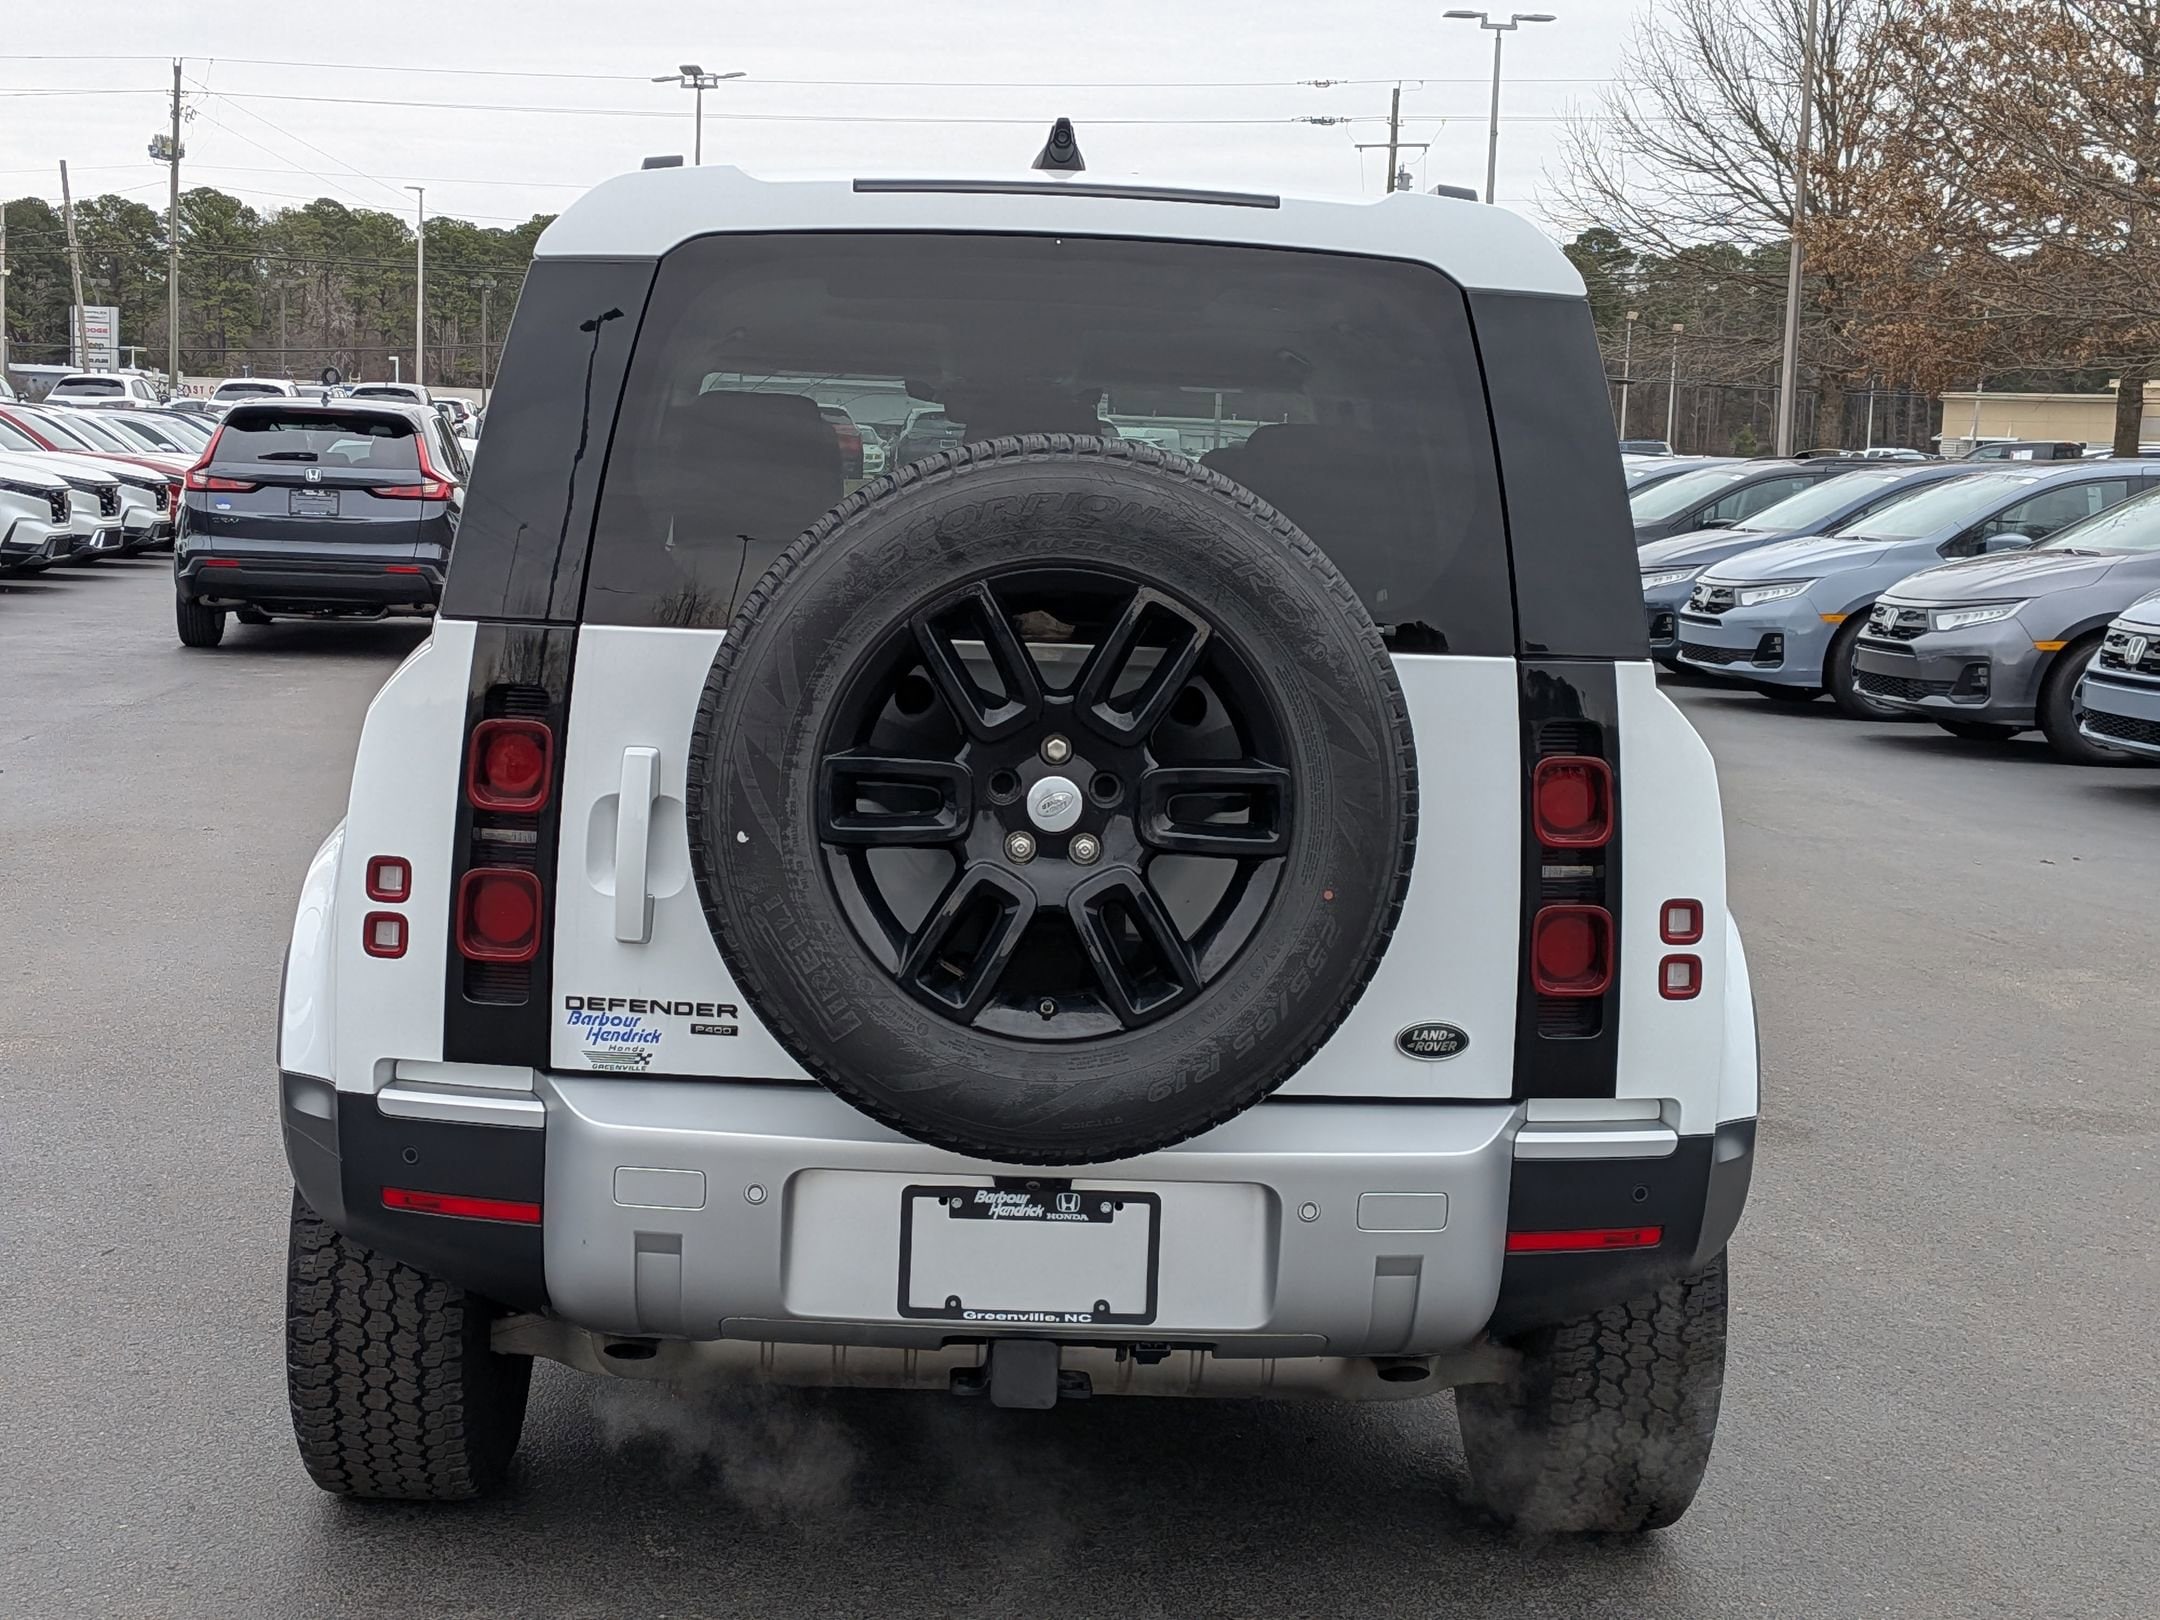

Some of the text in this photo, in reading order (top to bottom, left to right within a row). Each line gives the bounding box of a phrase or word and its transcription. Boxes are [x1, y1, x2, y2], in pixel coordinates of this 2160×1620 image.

[565, 995, 738, 1019] DEFENDER
[567, 1010, 642, 1028] Barbour
[585, 1027, 663, 1046] Hendrick
[695, 1026, 732, 1035] P400
[1411, 1029, 1448, 1041] LAND
[608, 1044, 645, 1053] Honda
[1414, 1040, 1458, 1052] ROVER
[592, 1063, 647, 1072] GREENVILLE
[974, 1190, 1031, 1204] Barbour
[988, 1202, 1045, 1219] Hendrick
[1046, 1212, 1089, 1222] HONDA
[1064, 1313, 1092, 1323] NC
